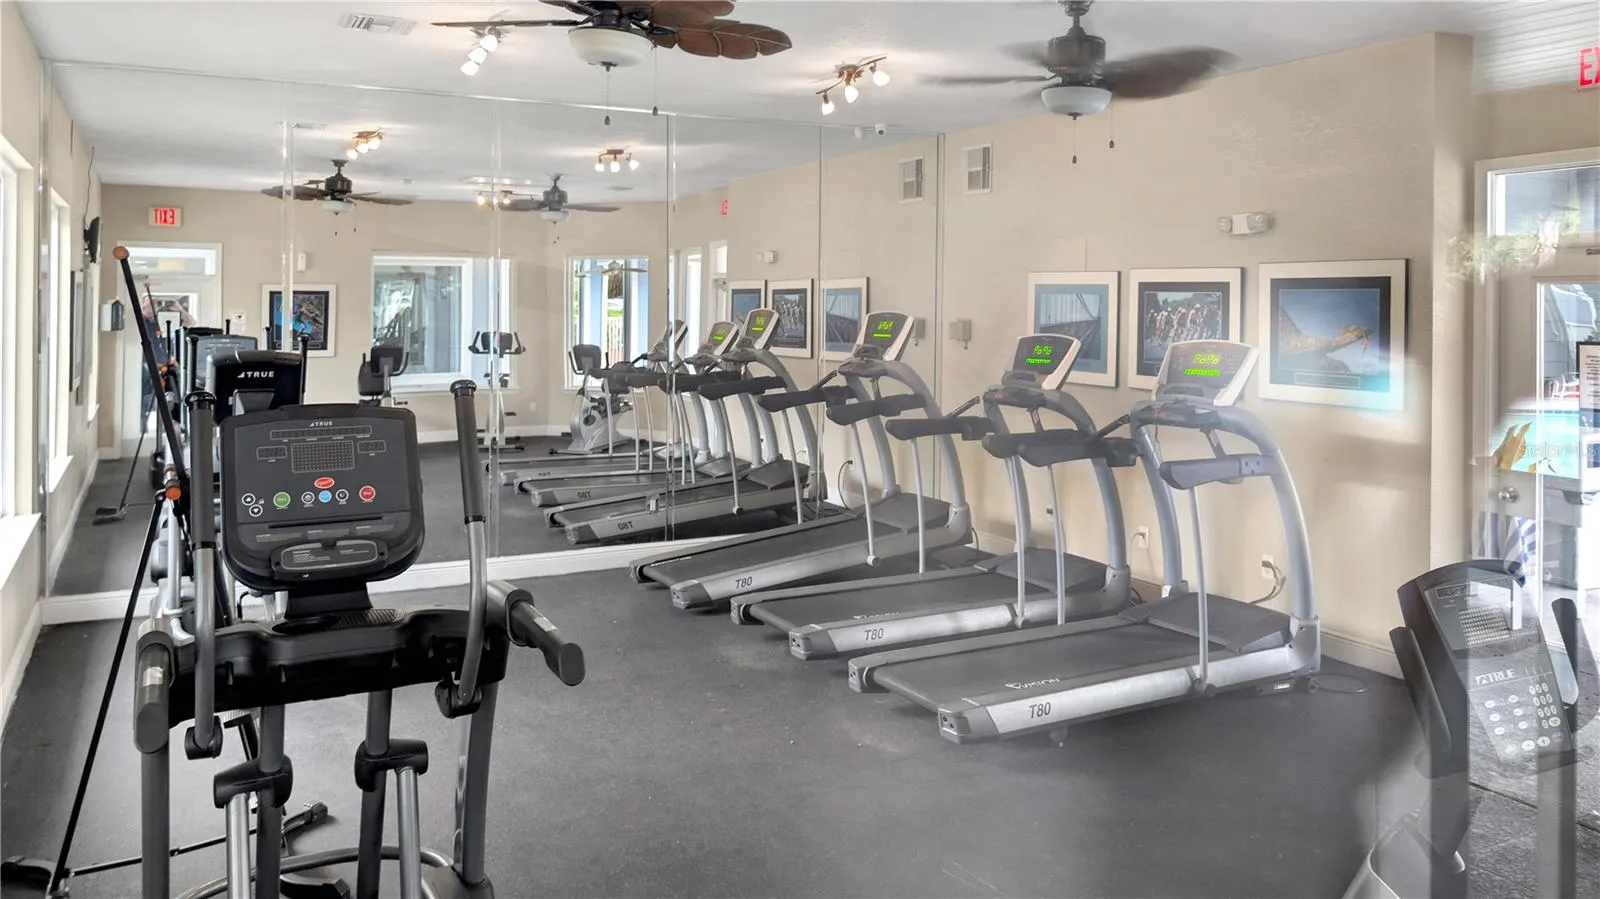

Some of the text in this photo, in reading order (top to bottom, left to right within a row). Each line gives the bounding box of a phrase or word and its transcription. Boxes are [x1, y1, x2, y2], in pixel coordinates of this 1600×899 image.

[735, 577, 753, 589] T80
[864, 627, 885, 641] T80
[1489, 669, 1516, 683] TRUE
[1029, 701, 1051, 719] T80
